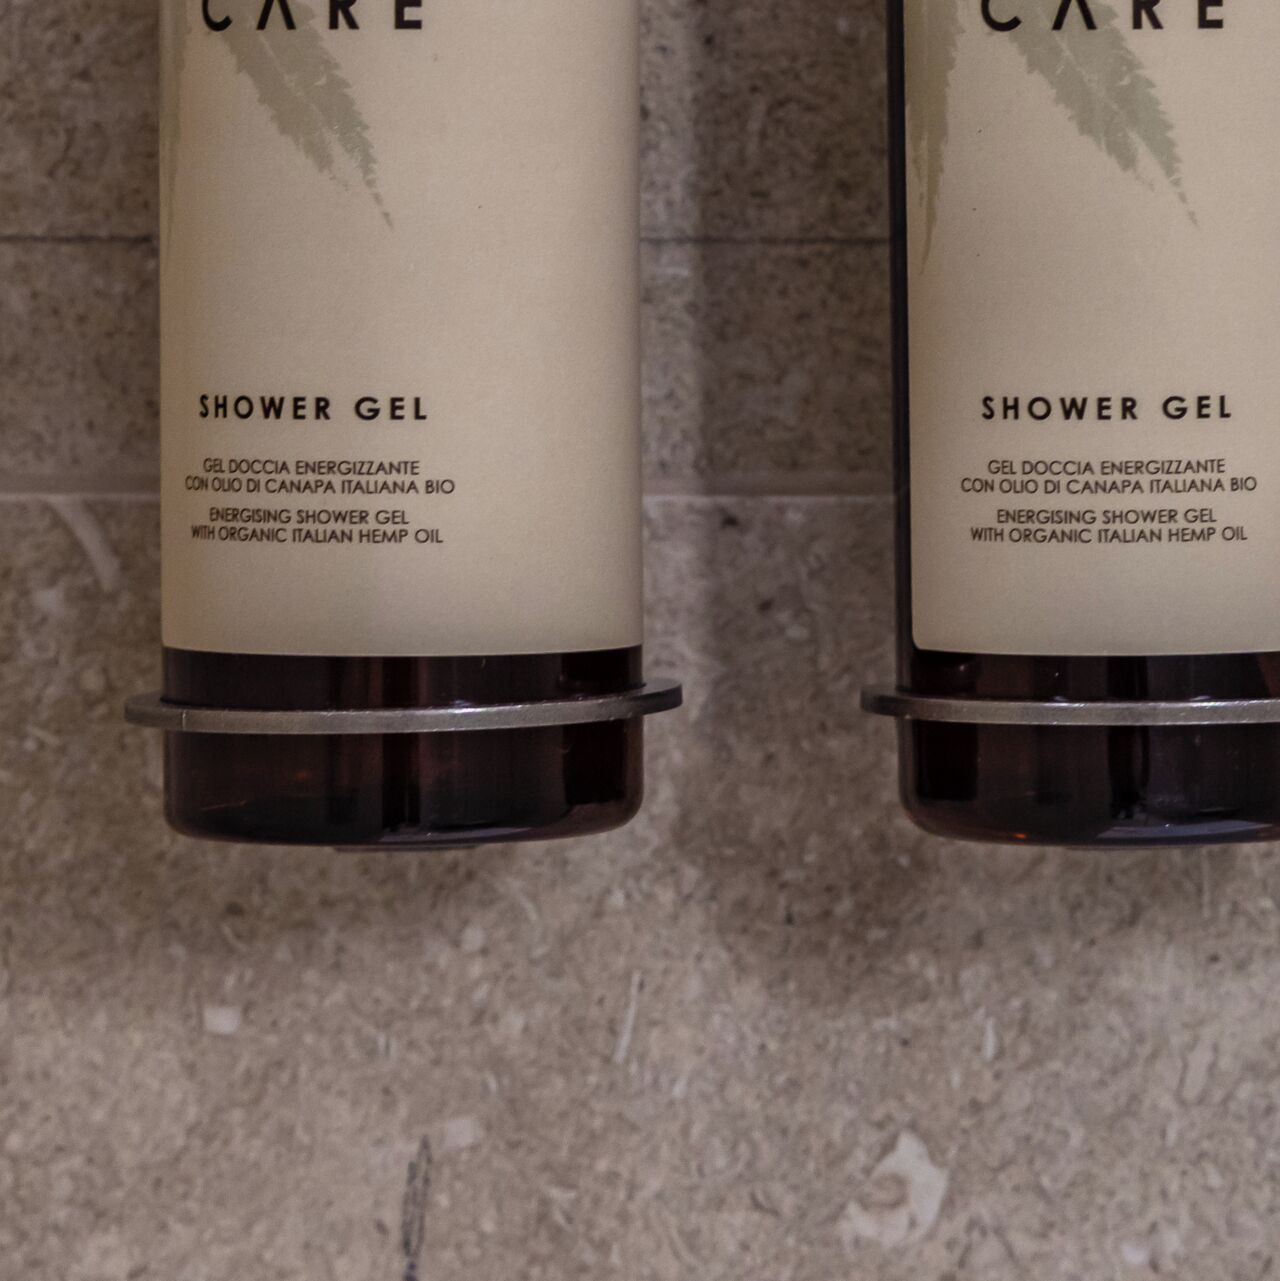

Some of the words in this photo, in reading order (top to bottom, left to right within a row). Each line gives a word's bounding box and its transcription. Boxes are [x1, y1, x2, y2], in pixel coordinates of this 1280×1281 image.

[199, 394, 331, 420] SHOWER
[355, 396, 428, 420] GEL
[981, 396, 1138, 421] SHOWER
[1162, 395, 1232, 419] GEL
[203, 458, 225, 472] GEL
[228, 459, 289, 475] DOCCIA
[296, 460, 420, 476] ENERGIZZANTE
[987, 460, 1017, 475] GEL
[1022, 460, 1095, 475] DOCCIA
[1101, 459, 1226, 475] ENERGIZZANTE
[185, 476, 208, 491] CON
[212, 477, 242, 492] OLIO
[246, 478, 260, 493] DI
[265, 478, 336, 494] CANAPA
[342, 479, 418, 494] ITALIANA
[425, 479, 456, 494] BIO
[961, 478, 994, 493] CON
[999, 479, 1038, 494] OLIO
[1044, 479, 1061, 494] DI
[1066, 479, 1144, 494] CANAPA
[1150, 478, 1225, 494] ITALIANA
[1230, 476, 1257, 492] BIO
[209, 507, 292, 524] ENERGISING
[296, 509, 368, 525] SHOWER
[375, 510, 409, 525] GEL
[997, 509, 1096, 524] ENERGISING
[1102, 509, 1177, 524] SHOWER
[1184, 509, 1217, 523] GEL
[191, 526, 215, 540] WITH
[218, 526, 287, 542] ORGANIC
[292, 528, 352, 544] ITALIAN
[359, 528, 408, 544] HEMP
[414, 528, 443, 544] OIL
[971, 527, 1004, 542] WITH
[1009, 528, 1092, 543] ORGANIC
[1098, 528, 1162, 543] ITALIAN
[1168, 527, 1216, 542] HEMP
[1221, 526, 1248, 541] OIL
